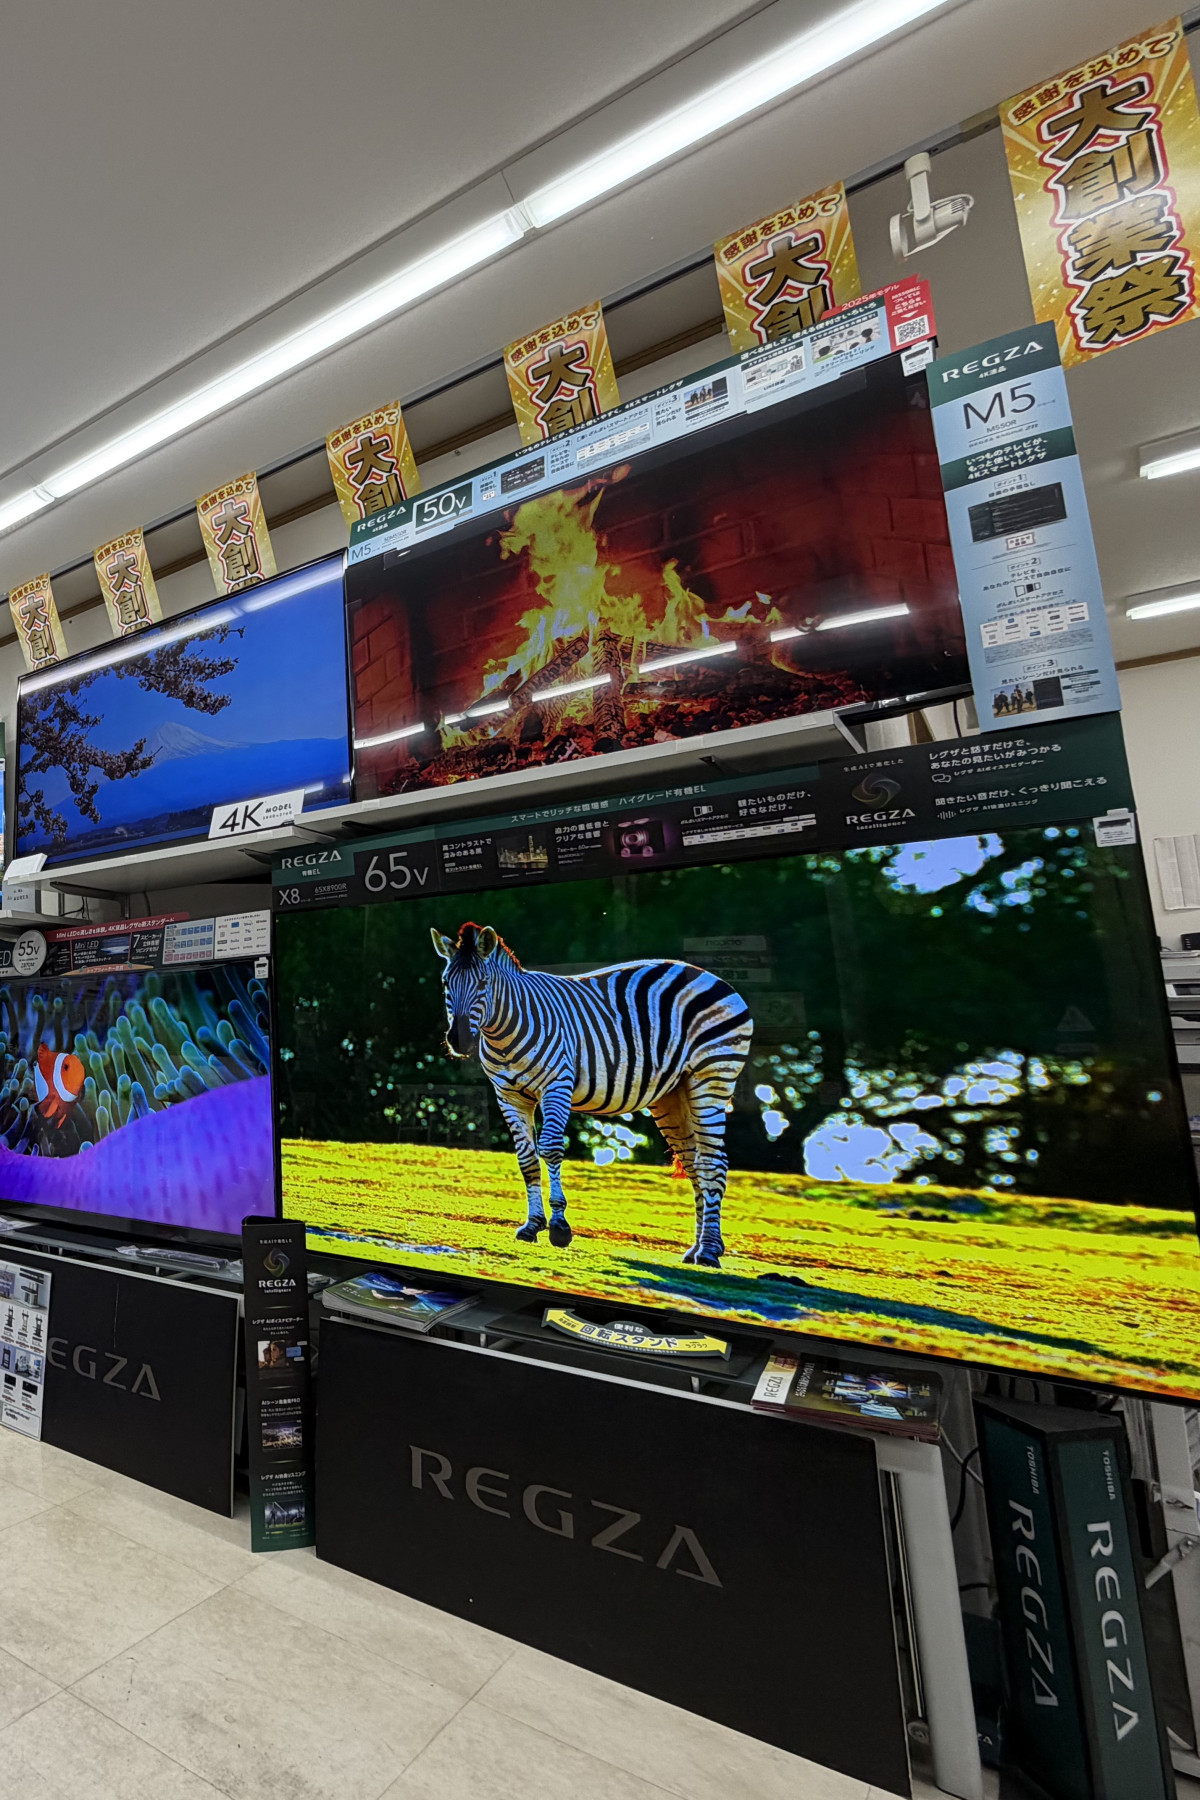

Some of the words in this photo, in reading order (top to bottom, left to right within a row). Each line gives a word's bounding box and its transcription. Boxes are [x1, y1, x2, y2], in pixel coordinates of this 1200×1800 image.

[1011, 34, 1174, 123] 感謝を込めて
[1046, 78, 1189, 345] 大創業祭
[723, 196, 838, 262] 感謝を込めて
[841, 284, 900, 311] 2025年モデル
[510, 313, 596, 363] 感謝を込めて
[942, 341, 1044, 383] REGZA
[962, 381, 1037, 431] M5
[331, 411, 398, 450] 感謝を込めて
[965, 437, 1048, 466] いつものテレビが、
[967, 451, 1047, 480] 4Kスマートレグザ
[200, 480, 255, 513] 感謝を込めて
[356, 505, 407, 532] REGZA
[97, 534, 141, 562] 感謝を込めて
[351, 543, 372, 560] M5
[108, 553, 150, 635] 大創
[928, 738, 1031, 761] レグザと話すだけで、
[930, 743, 1062, 770] あなたの見たいがみつかる
[511, 800, 609, 823] スマートでリッチな臨場感
[619, 784, 707, 805] ハイグレード有機EL
[737, 791, 812, 808] 観たいものだけ、
[935, 776, 1108, 806] 聞きたい音だけ、くっきり聞こえる
[219, 801, 265, 832] 4K
[265, 803, 292, 814] MODEL
[738, 803, 793, 818] 好きなだけ。
[845, 808, 917, 825] REGZA
[554, 820, 610, 835] 迫力の重低音と
[442, 838, 492, 851] 高コントラストで
[281, 850, 342, 870] REGZA
[363, 852, 429, 892] 65v
[279, 887, 300, 906] X8
[258, 1279, 297, 1288] REGZA
[579, 1323, 679, 1348] 回転スタンド
[613, 1322, 644, 1334] 便利な
[46, 1336, 162, 1402] EGZA
[763, 1376, 784, 1398] REGZA
[1026, 1445, 1041, 1495] TOSHIBA
[1102, 1449, 1116, 1501] TOSHIBA
[409, 1444, 725, 1589] REGZA
[1007, 1499, 1060, 1708] REGZA
[1086, 1520, 1140, 1742] REGZA
